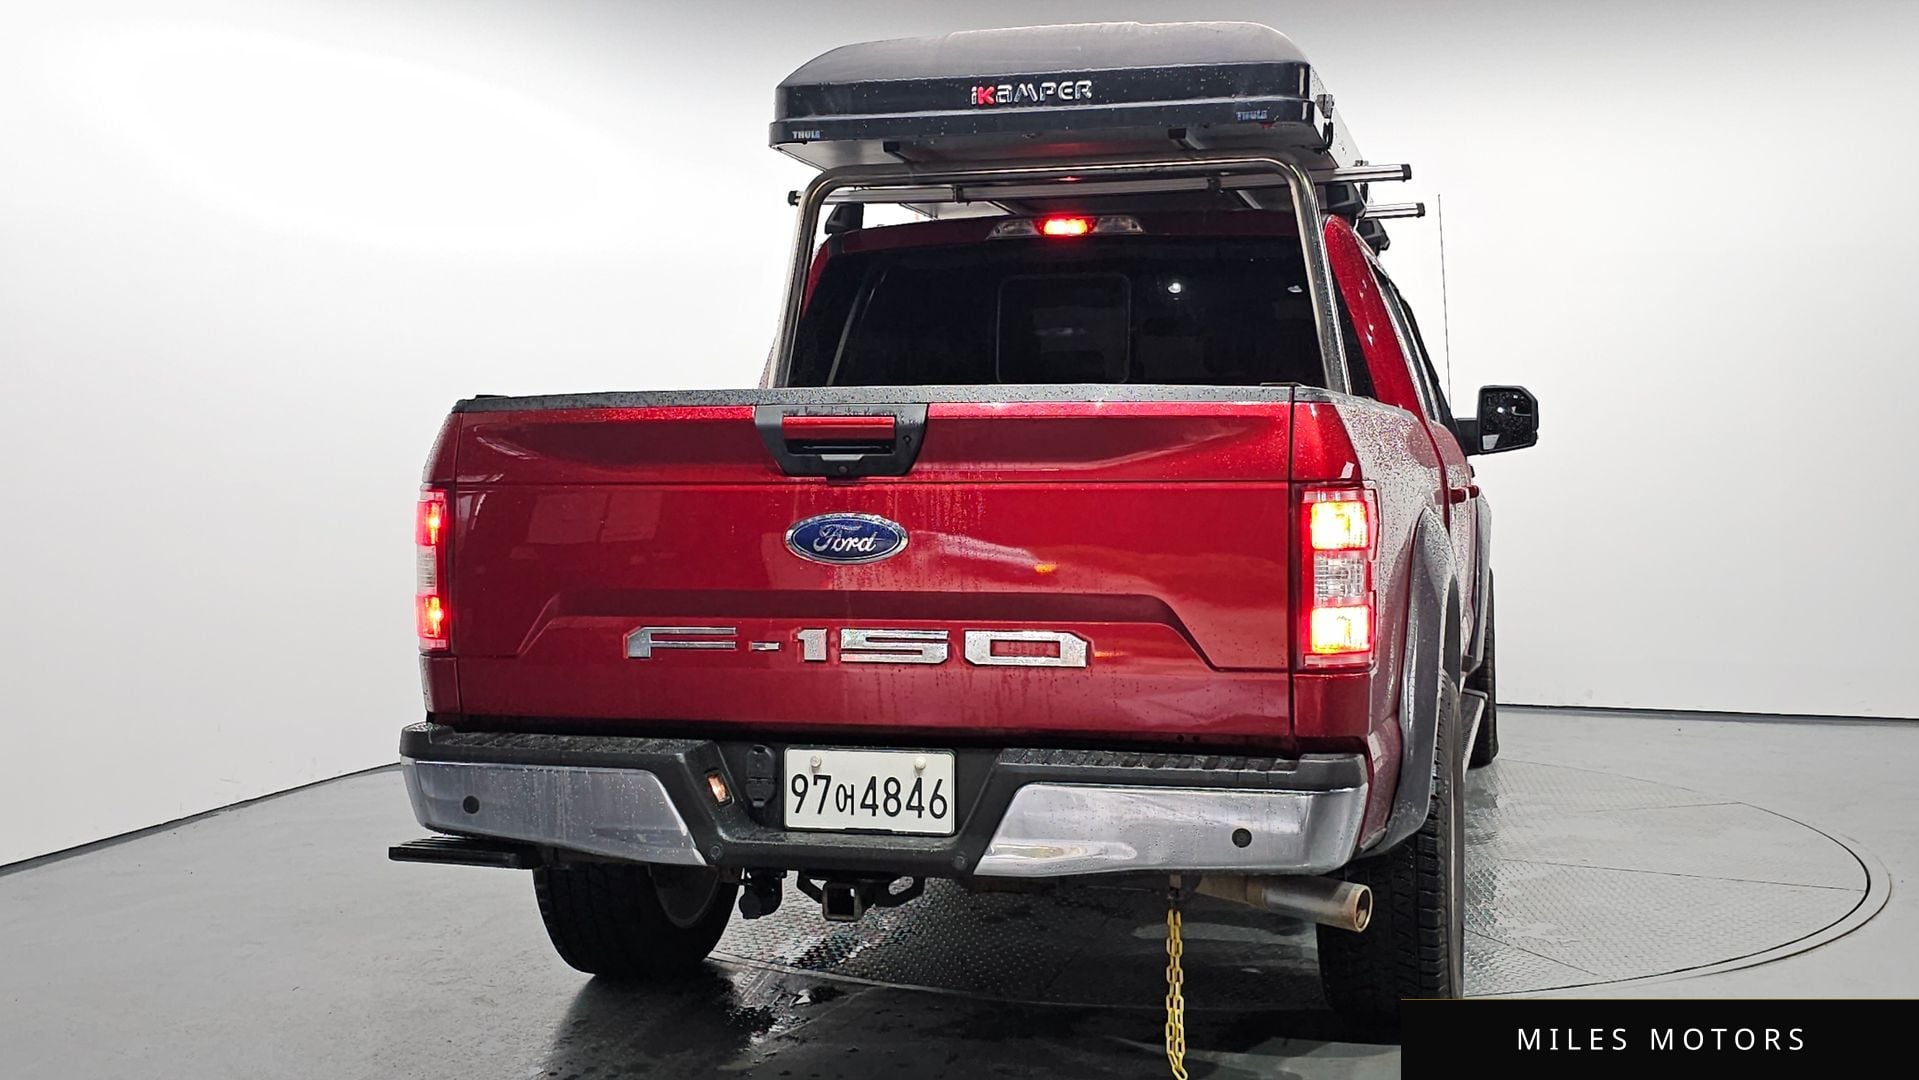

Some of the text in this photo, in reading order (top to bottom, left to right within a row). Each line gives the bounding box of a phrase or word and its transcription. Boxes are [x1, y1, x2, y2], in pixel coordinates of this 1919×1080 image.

[792, 130, 821, 139] THULE
[813, 524, 878, 552] Ford
[625, 626, 1088, 668] F-150
[791, 773, 948, 819] 97어4846
